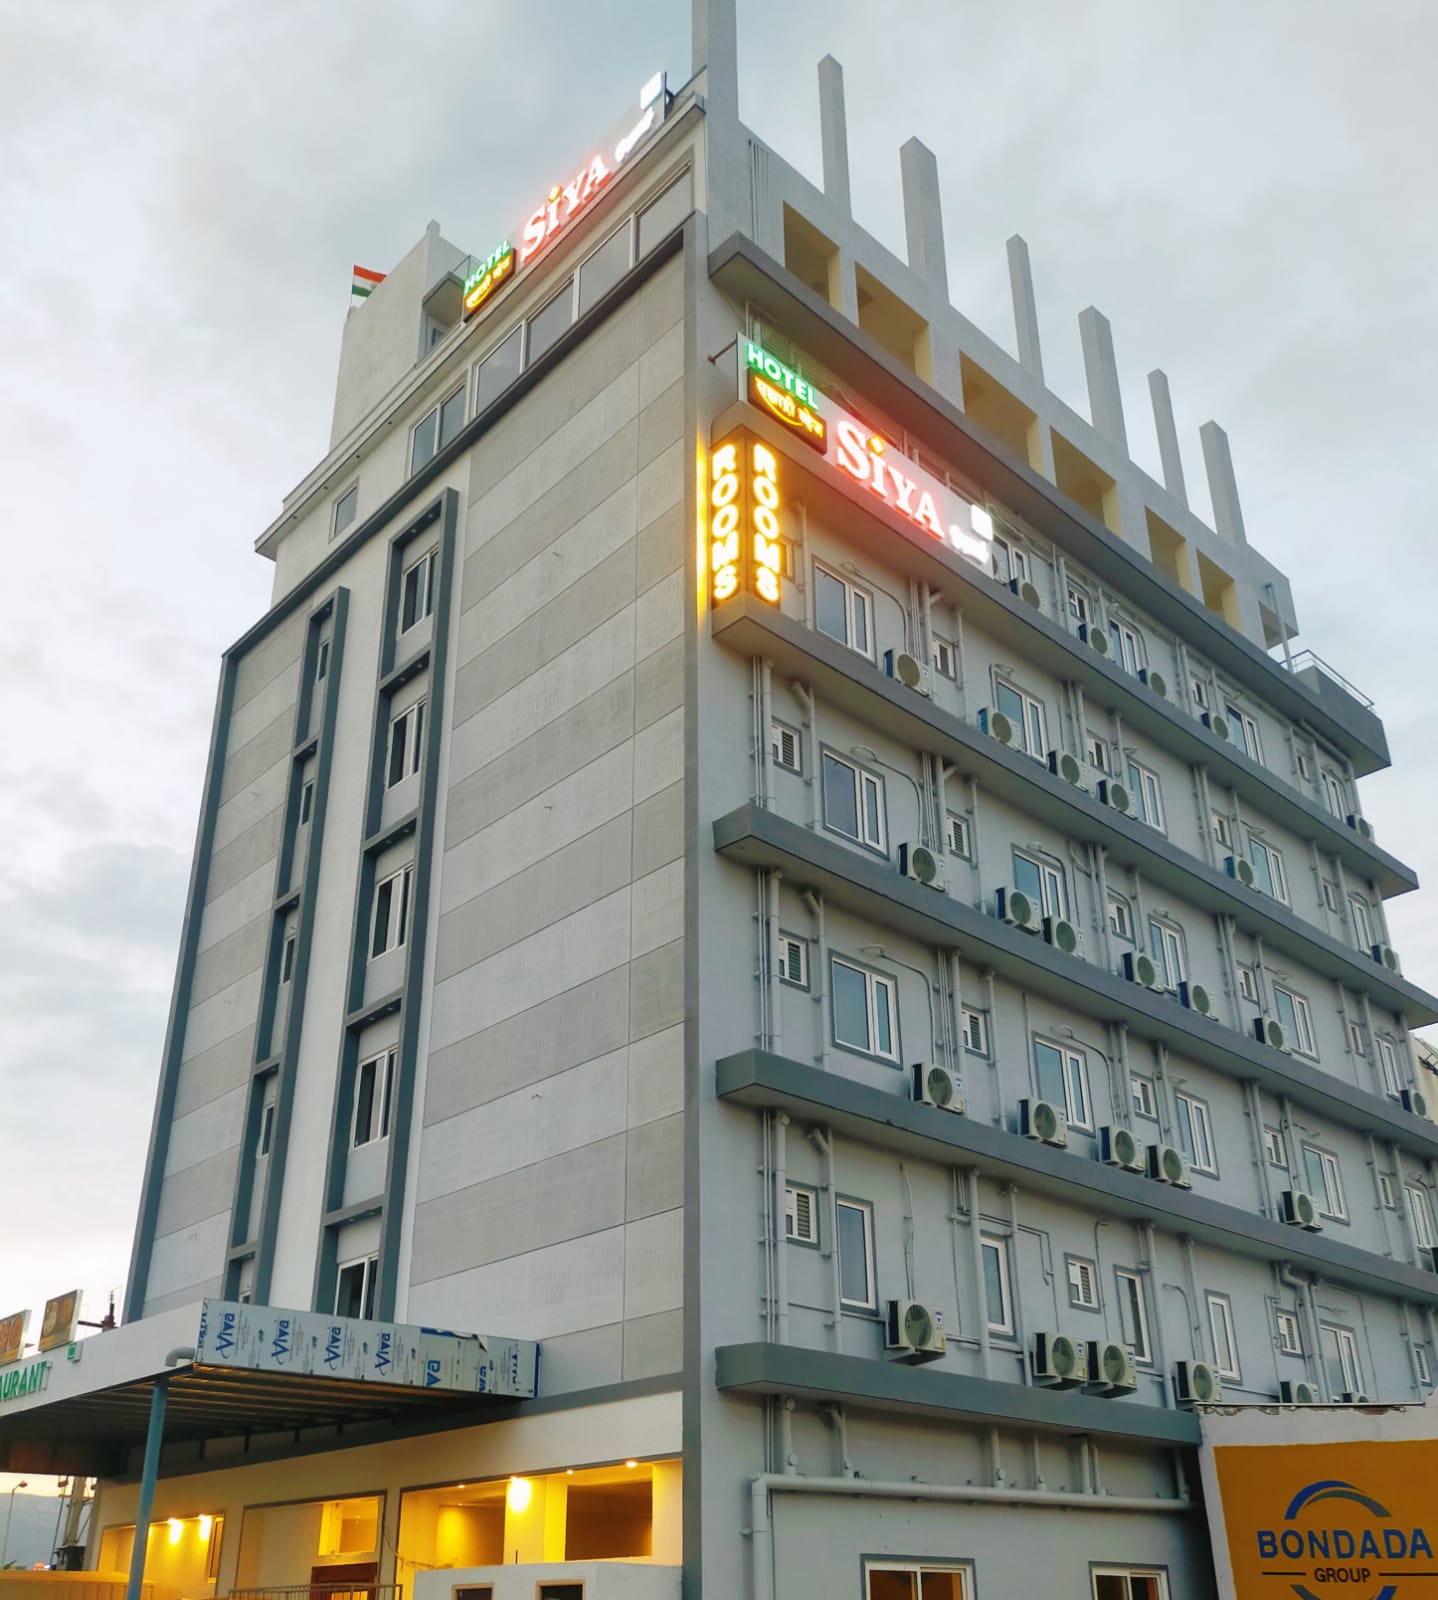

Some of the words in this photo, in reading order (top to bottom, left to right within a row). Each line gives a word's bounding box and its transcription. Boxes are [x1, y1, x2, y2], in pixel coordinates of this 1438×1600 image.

[464, 239, 511, 296] HOTEL
[747, 343, 819, 410] HOTEL
[711, 444, 739, 600] ROOMS
[753, 443, 780, 602] ROOMS
[215, 1312, 236, 1359] Viva
[271, 1319, 290, 1365] Viva
[324, 1326, 342, 1371] Viva
[374, 1332, 391, 1376] Viva
[1256, 1528, 1434, 1559] BONDADA
[1314, 1567, 1371, 1583] GROUP
